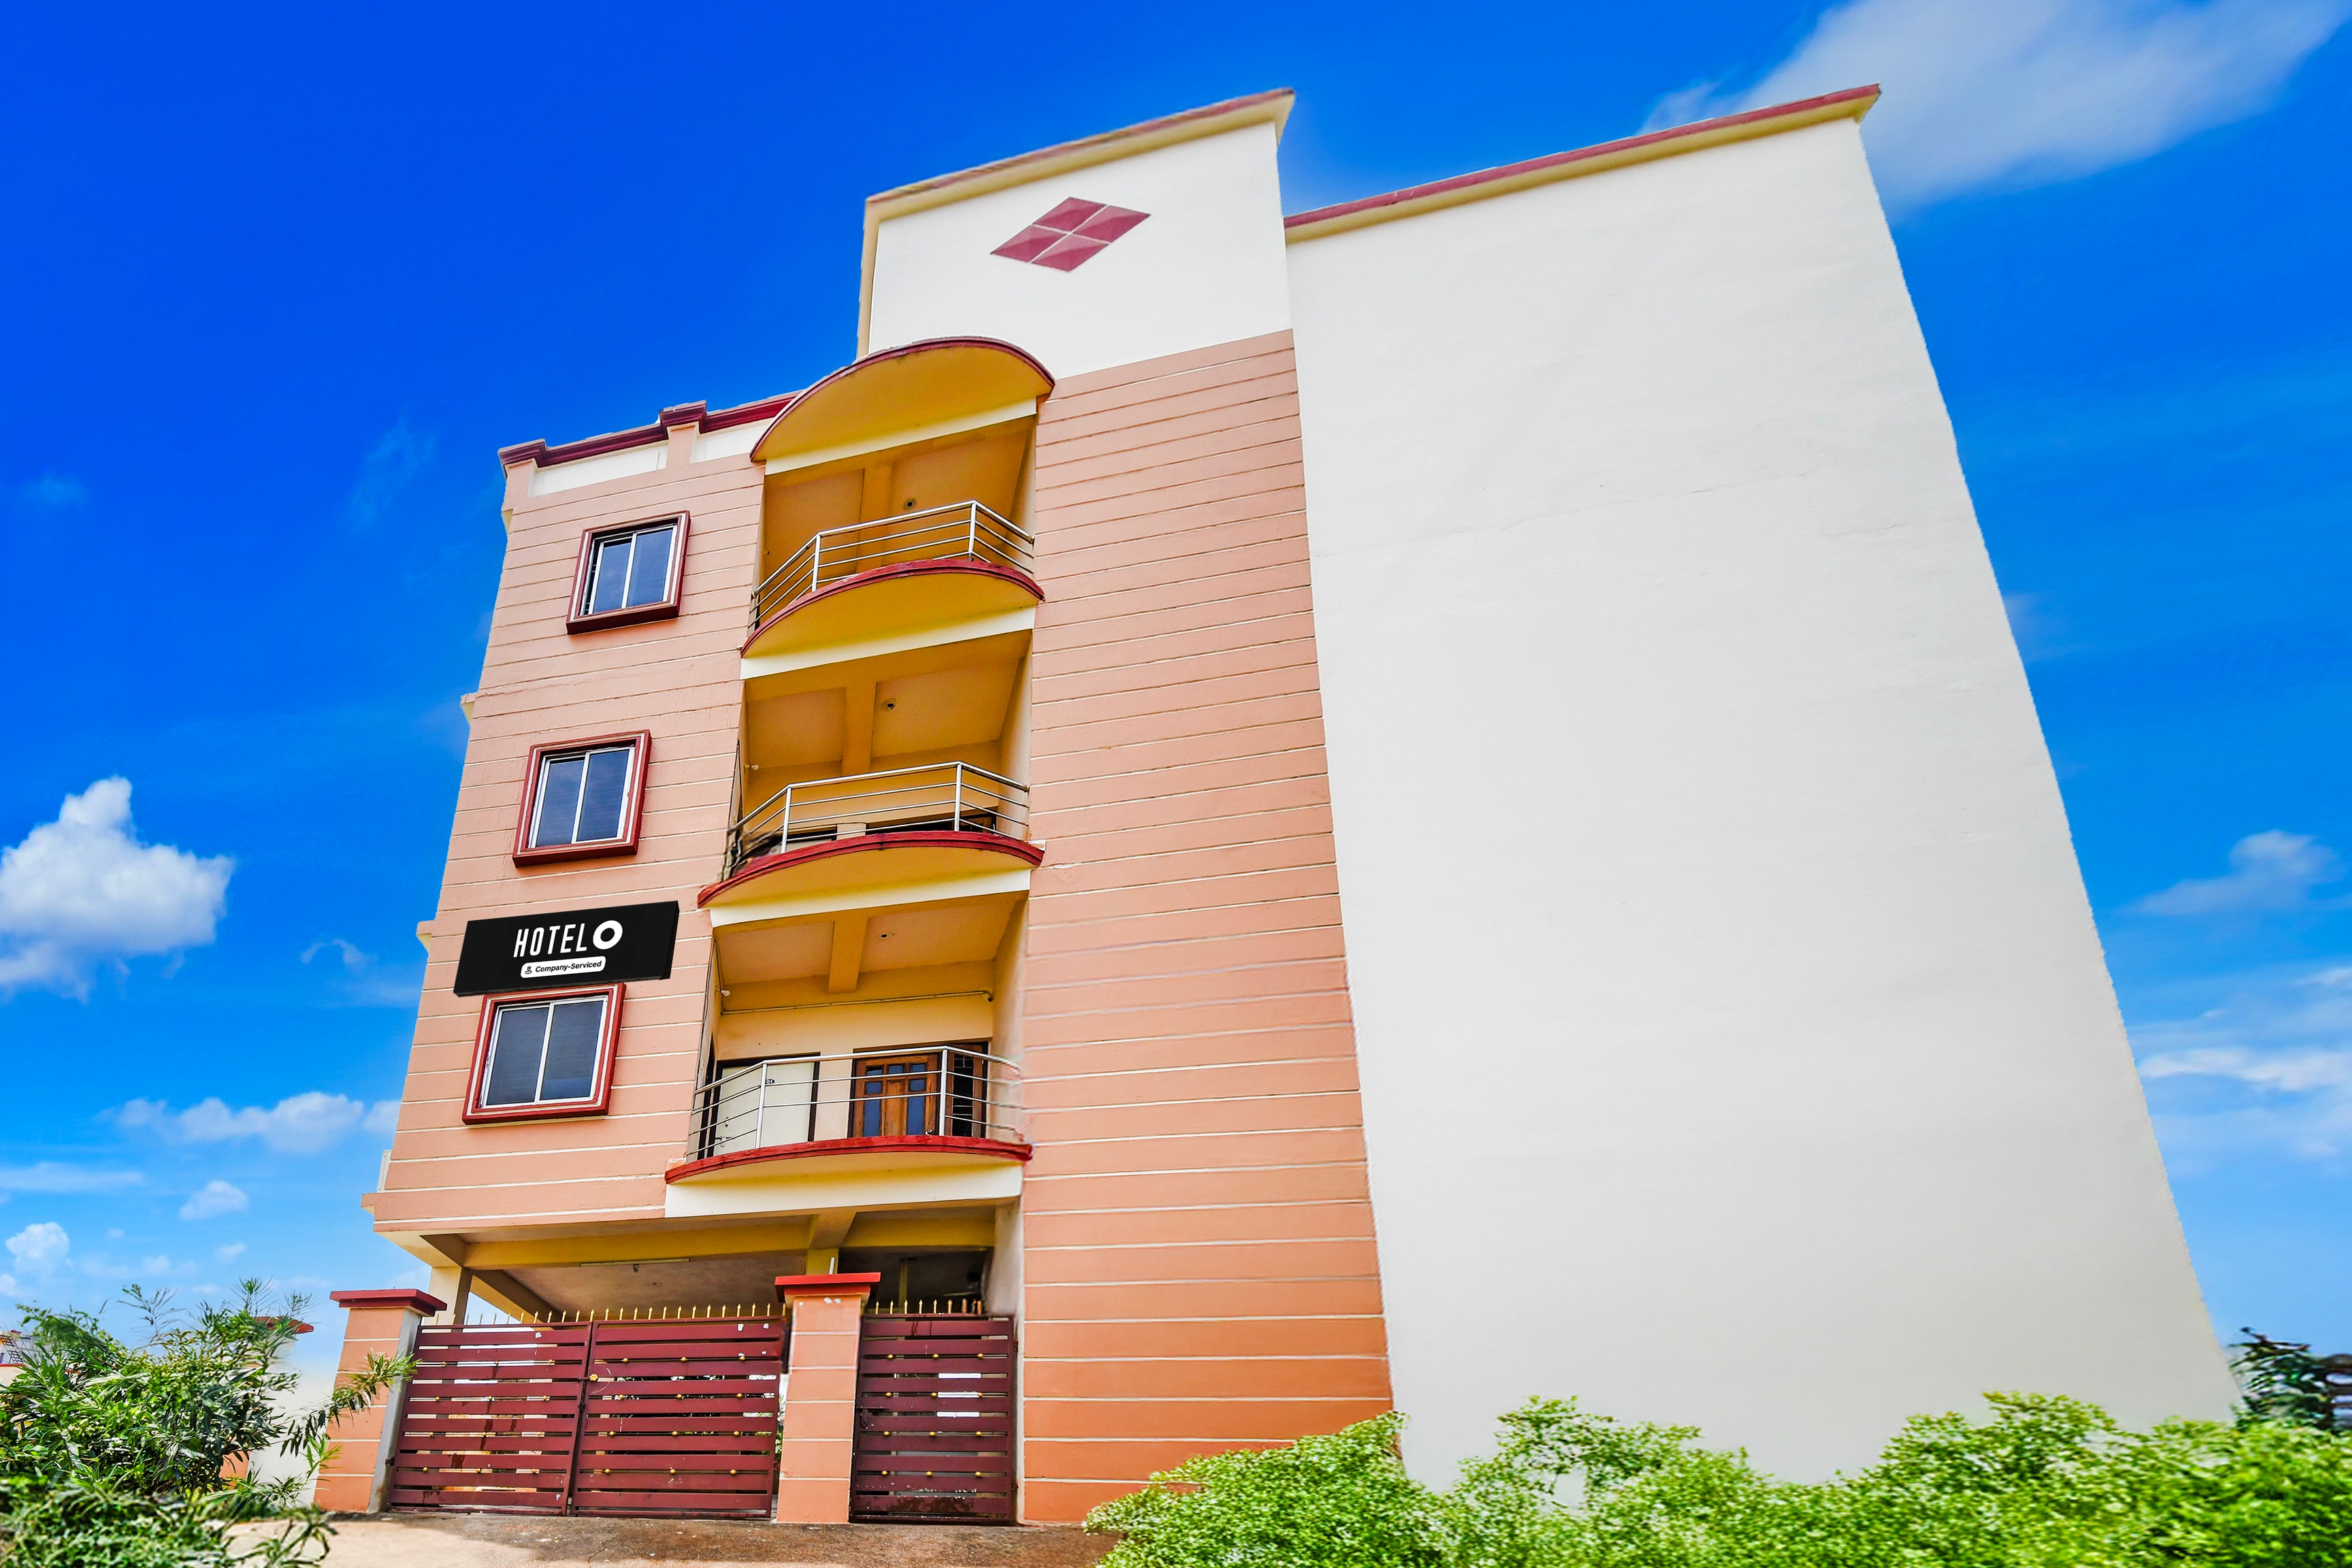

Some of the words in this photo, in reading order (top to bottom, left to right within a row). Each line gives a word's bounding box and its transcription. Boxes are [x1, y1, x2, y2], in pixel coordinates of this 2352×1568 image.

[513, 923, 587, 958] HOTEL
[593, 920, 623, 950] O
[535, 960, 602, 973] Company-Serviced
